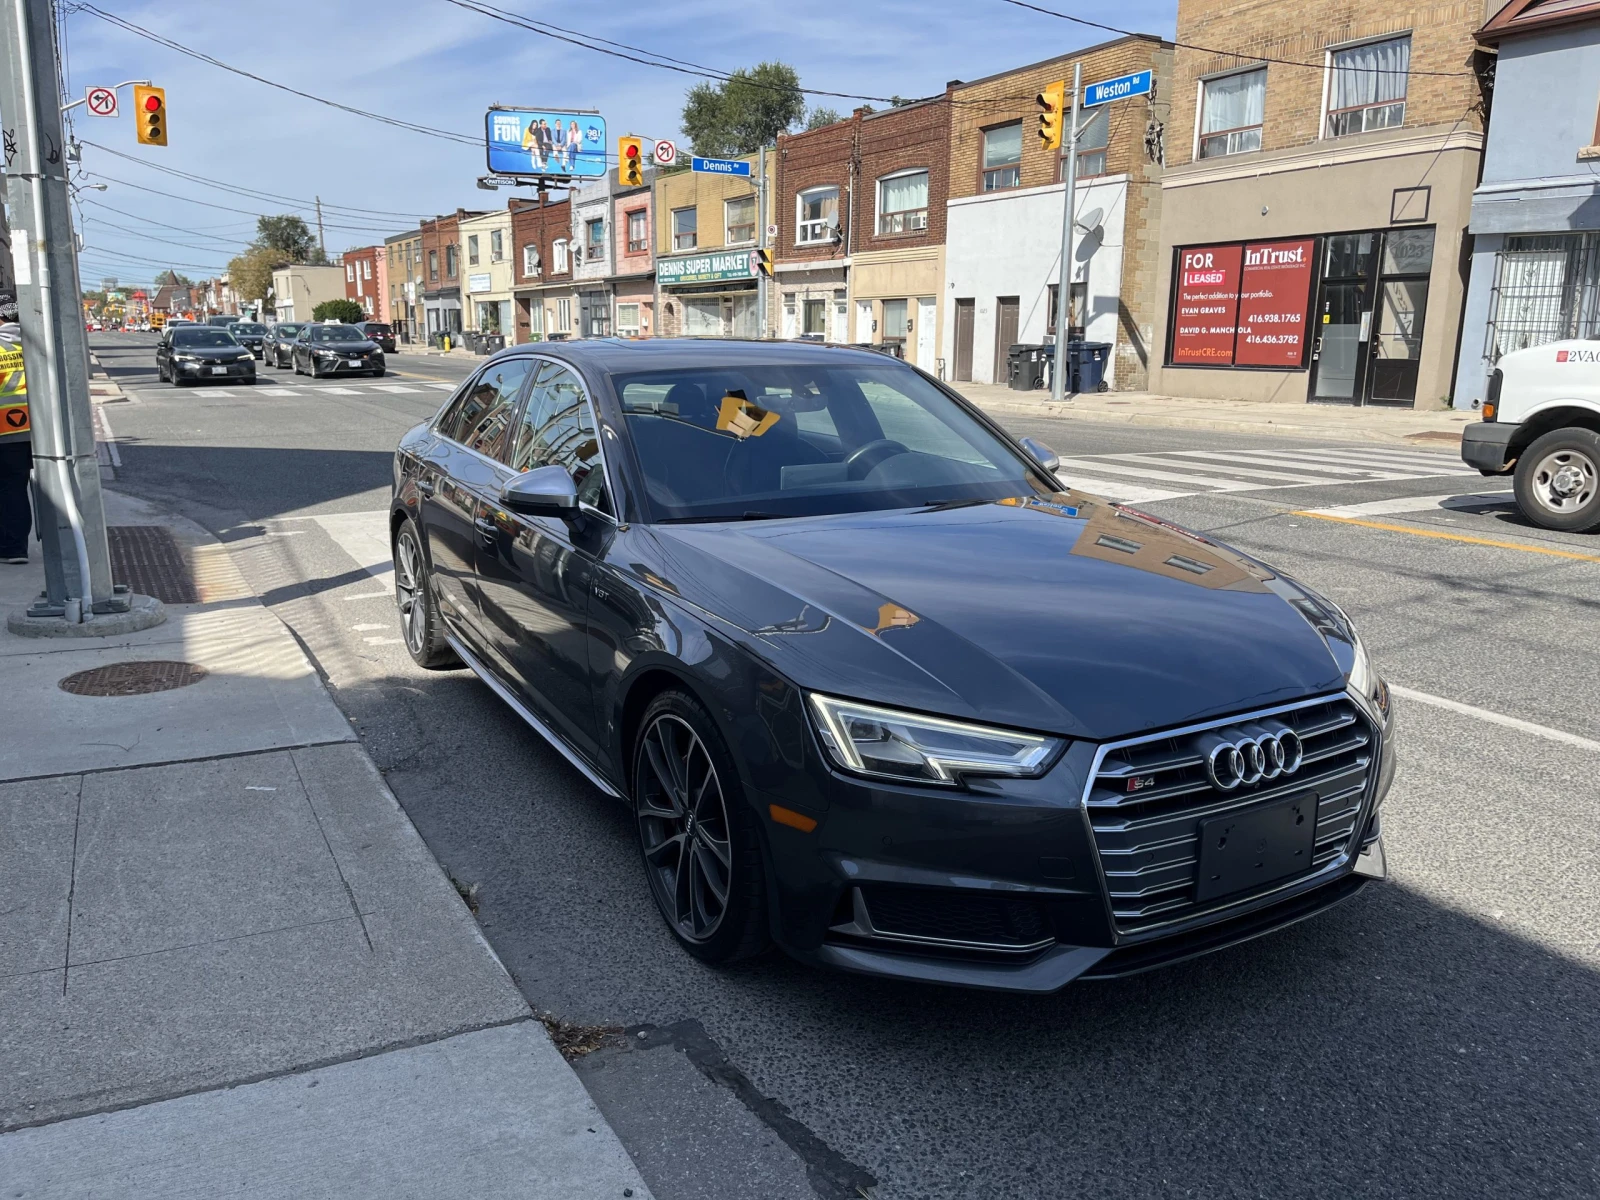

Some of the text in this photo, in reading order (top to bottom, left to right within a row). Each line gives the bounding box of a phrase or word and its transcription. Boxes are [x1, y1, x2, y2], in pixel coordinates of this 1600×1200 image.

[1096, 76, 1140, 100] Weston Rd
[494, 124, 520, 142] FUN
[703, 160, 732, 172] Dennis
[659, 254, 748, 276] DENNIS SUPER MARKET
[1185, 253, 1213, 269] FOR
[1190, 273, 1223, 284] LEASED
[1192, 292, 1208, 301] perfect
[1248, 314, 1301, 323] 416.938.1765
[1246, 335, 1299, 344] 416.436.3782
[1178, 348, 1232, 357] InTrustCRE.com
[1134, 777, 1155, 789] S4
